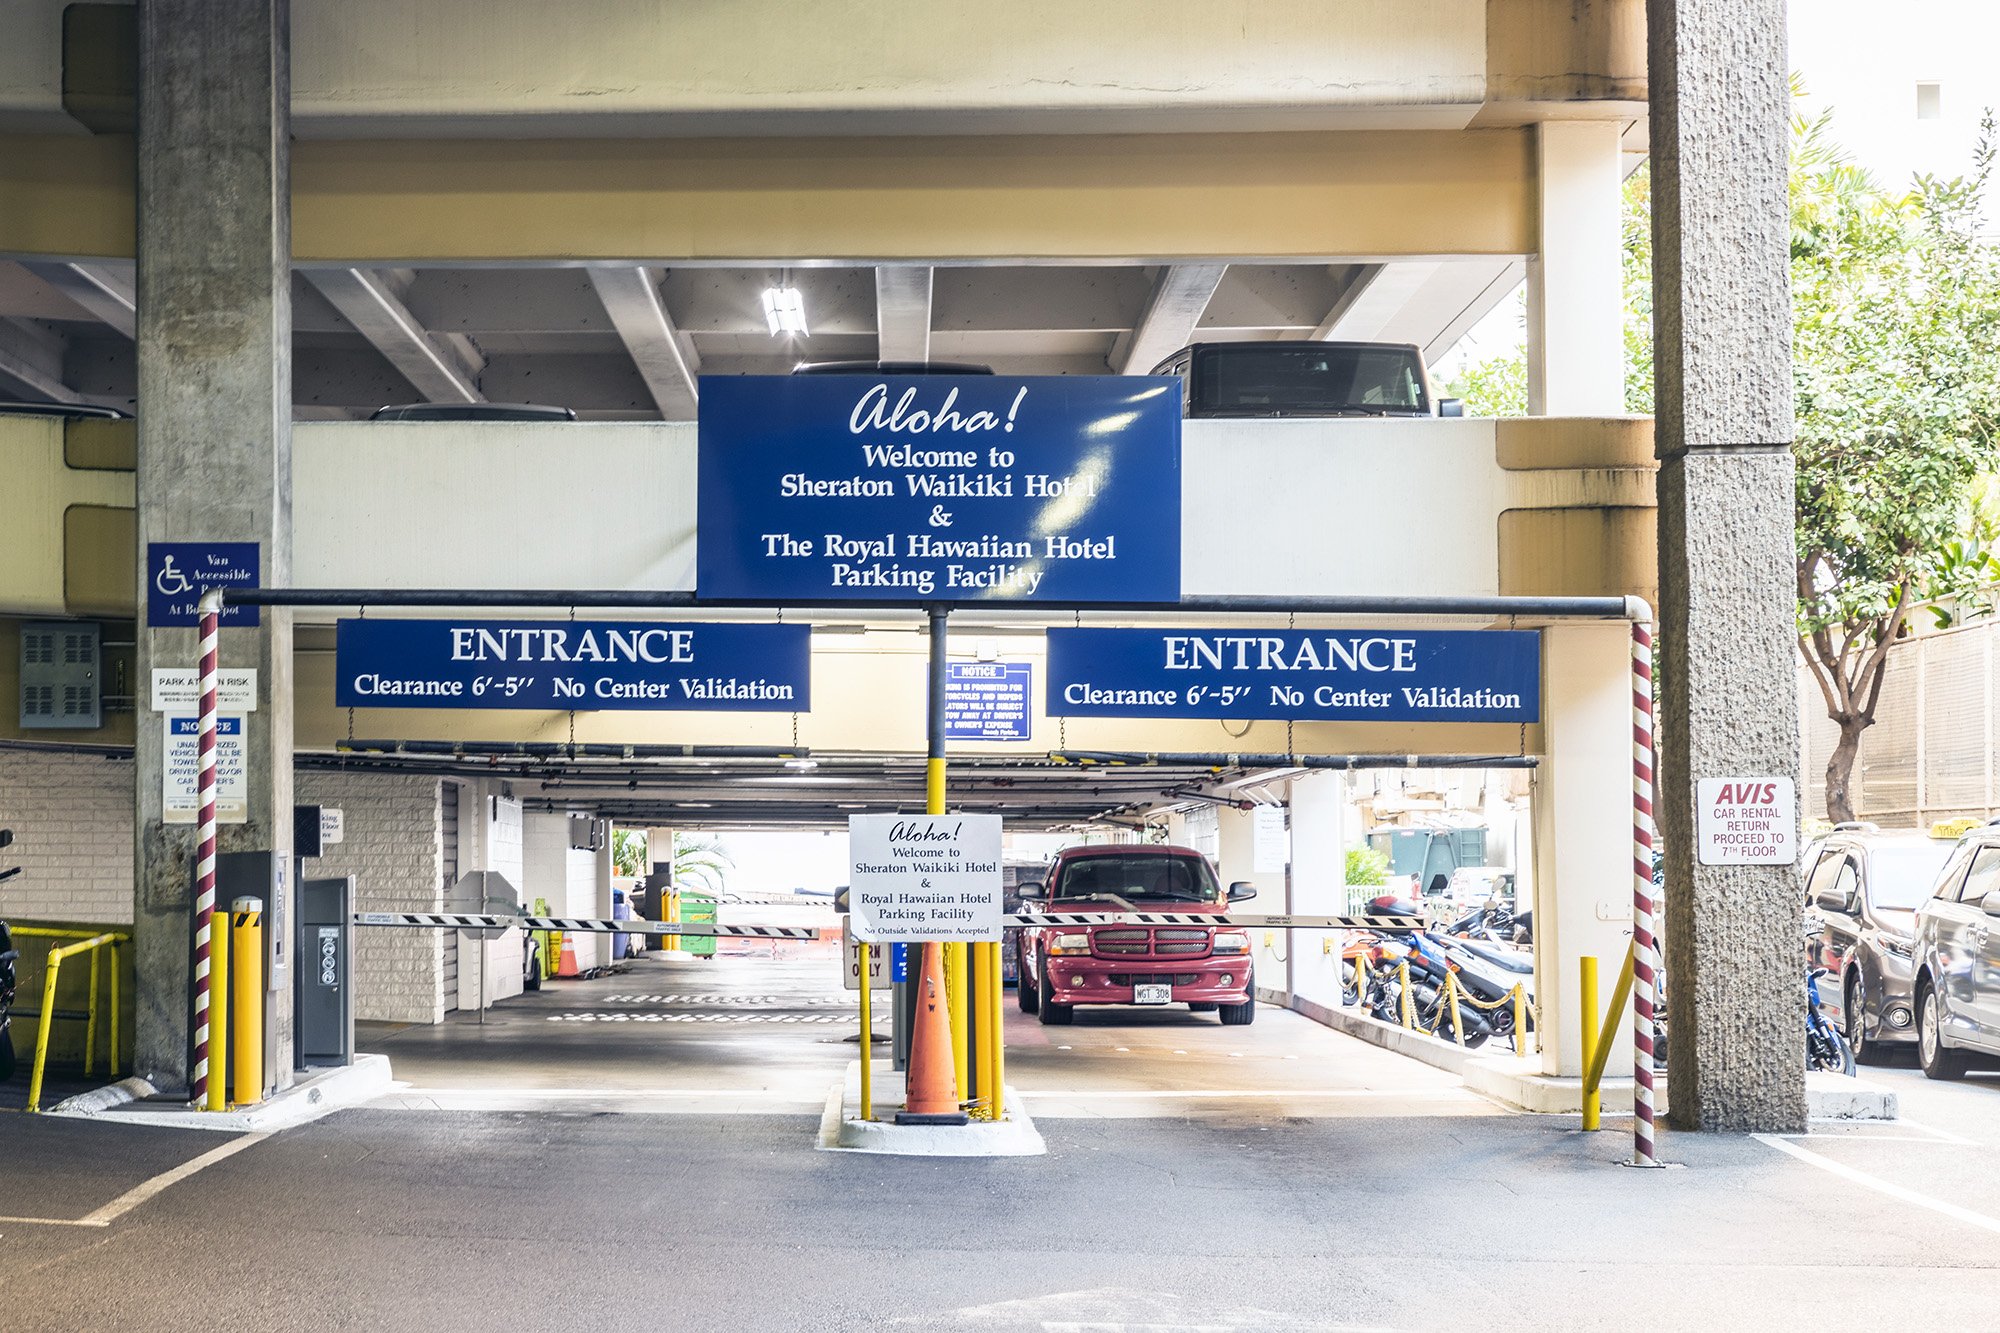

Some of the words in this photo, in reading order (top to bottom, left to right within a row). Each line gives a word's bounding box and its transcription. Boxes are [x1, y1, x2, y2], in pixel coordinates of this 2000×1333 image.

[849, 383, 1028, 434] Aloha!
[862, 445, 978, 468] Welcome
[989, 447, 1015, 468] to
[780, 474, 894, 497] Sheraton
[906, 474, 1013, 497] Waikiki
[928, 505, 953, 528] &
[761, 534, 813, 557] The
[824, 534, 895, 564] Royal
[907, 534, 1032, 559] Hawaiian
[1045, 536, 1116, 560] Hotel
[207, 554, 229, 566] Van
[193, 569, 251, 580] Accessible
[831, 564, 935, 594] Parking
[946, 564, 1044, 594] Facility
[168, 604, 181, 615] At
[185, 604, 200, 615] Bu
[219, 605, 239, 618] pot
[450, 628, 694, 663] ENTRANCE
[1162, 636, 1417, 672] ENTRANCE
[962, 667, 996, 677] NOTICE
[159, 678, 185, 686] PARK
[188, 678, 200, 686] AT
[226, 678, 249, 686] RISK
[353, 674, 463, 696] Clearance
[552, 677, 586, 697] No
[594, 678, 670, 699] Center
[679, 679, 795, 701] Validation
[1063, 683, 1177, 706] Clearance
[1270, 686, 1304, 707] No
[1313, 687, 1391, 709] Center
[1401, 687, 1521, 710] Validation
[1715, 783, 1777, 805] AVIS
[321, 814, 338, 823] king
[1713, 808, 1736, 819] CAR
[1741, 808, 1781, 818] RENTAL
[889, 821, 963, 842] Aloha!
[1727, 821, 1770, 831] RETURN
[1713, 834, 1765, 844] PROCEED
[1770, 833, 1784, 844] TO
[893, 847, 944, 857] Welcome
[949, 848, 961, 857] to
[1722, 846, 1738, 857] 7TH
[1741, 846, 1777, 857] FLOOR
[855, 863, 907, 873] Sheraton
[912, 862, 960, 873] Waikiki
[965, 862, 997, 873] Hotel
[920, 878, 932, 888] &
[861, 893, 893, 907] Royal
[899, 893, 955, 904] Hawaiian
[960, 893, 992, 904] Hotel
[879, 909, 926, 921] Parking
[931, 909, 974, 921] Facility
[864, 927, 876, 935] No
[877, 927, 908, 935] Outside
[911, 927, 953, 935] Validations
[955, 927, 990, 936] Accepted
[852, 945, 881, 959] TRN
[852, 963, 881, 977] OLY
[1155, 988, 1170, 999] 308
